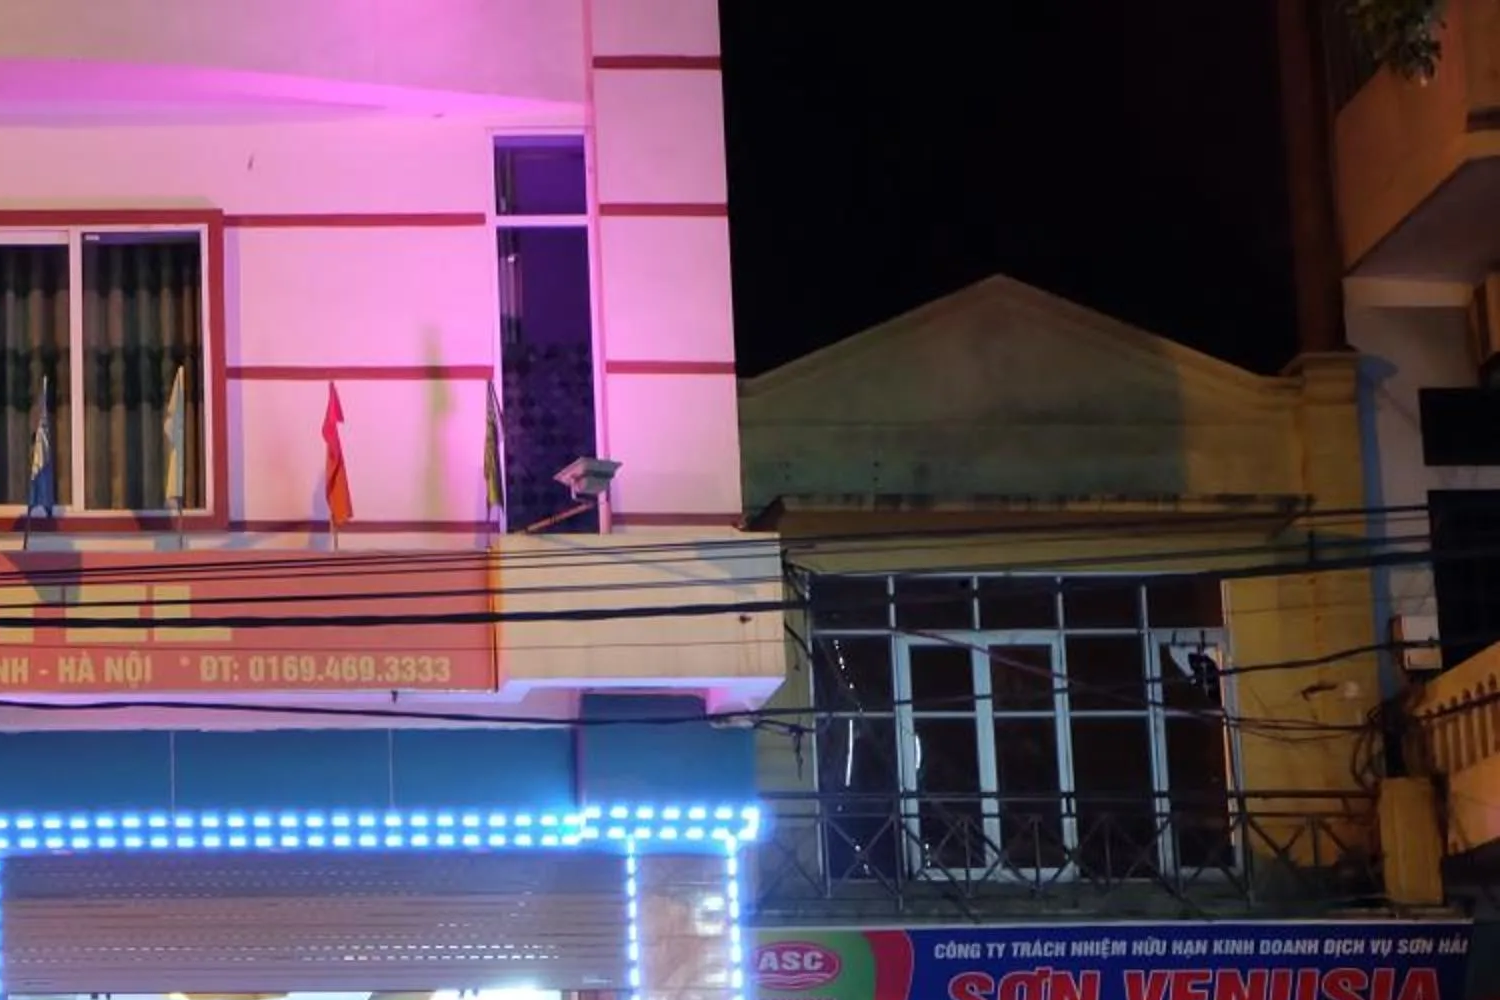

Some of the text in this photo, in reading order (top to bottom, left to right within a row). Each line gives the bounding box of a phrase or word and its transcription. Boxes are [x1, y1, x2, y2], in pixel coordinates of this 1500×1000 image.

[58, 650, 96, 684] HÀ
[248, 655, 452, 684] 0169.469.3333
[758, 950, 825, 972] ASC
[934, 941, 982, 960] CÔNG
[986, 943, 1007, 960] TY
[1213, 938, 1254, 956] KINH
[1259, 938, 1319, 955] DOANH
